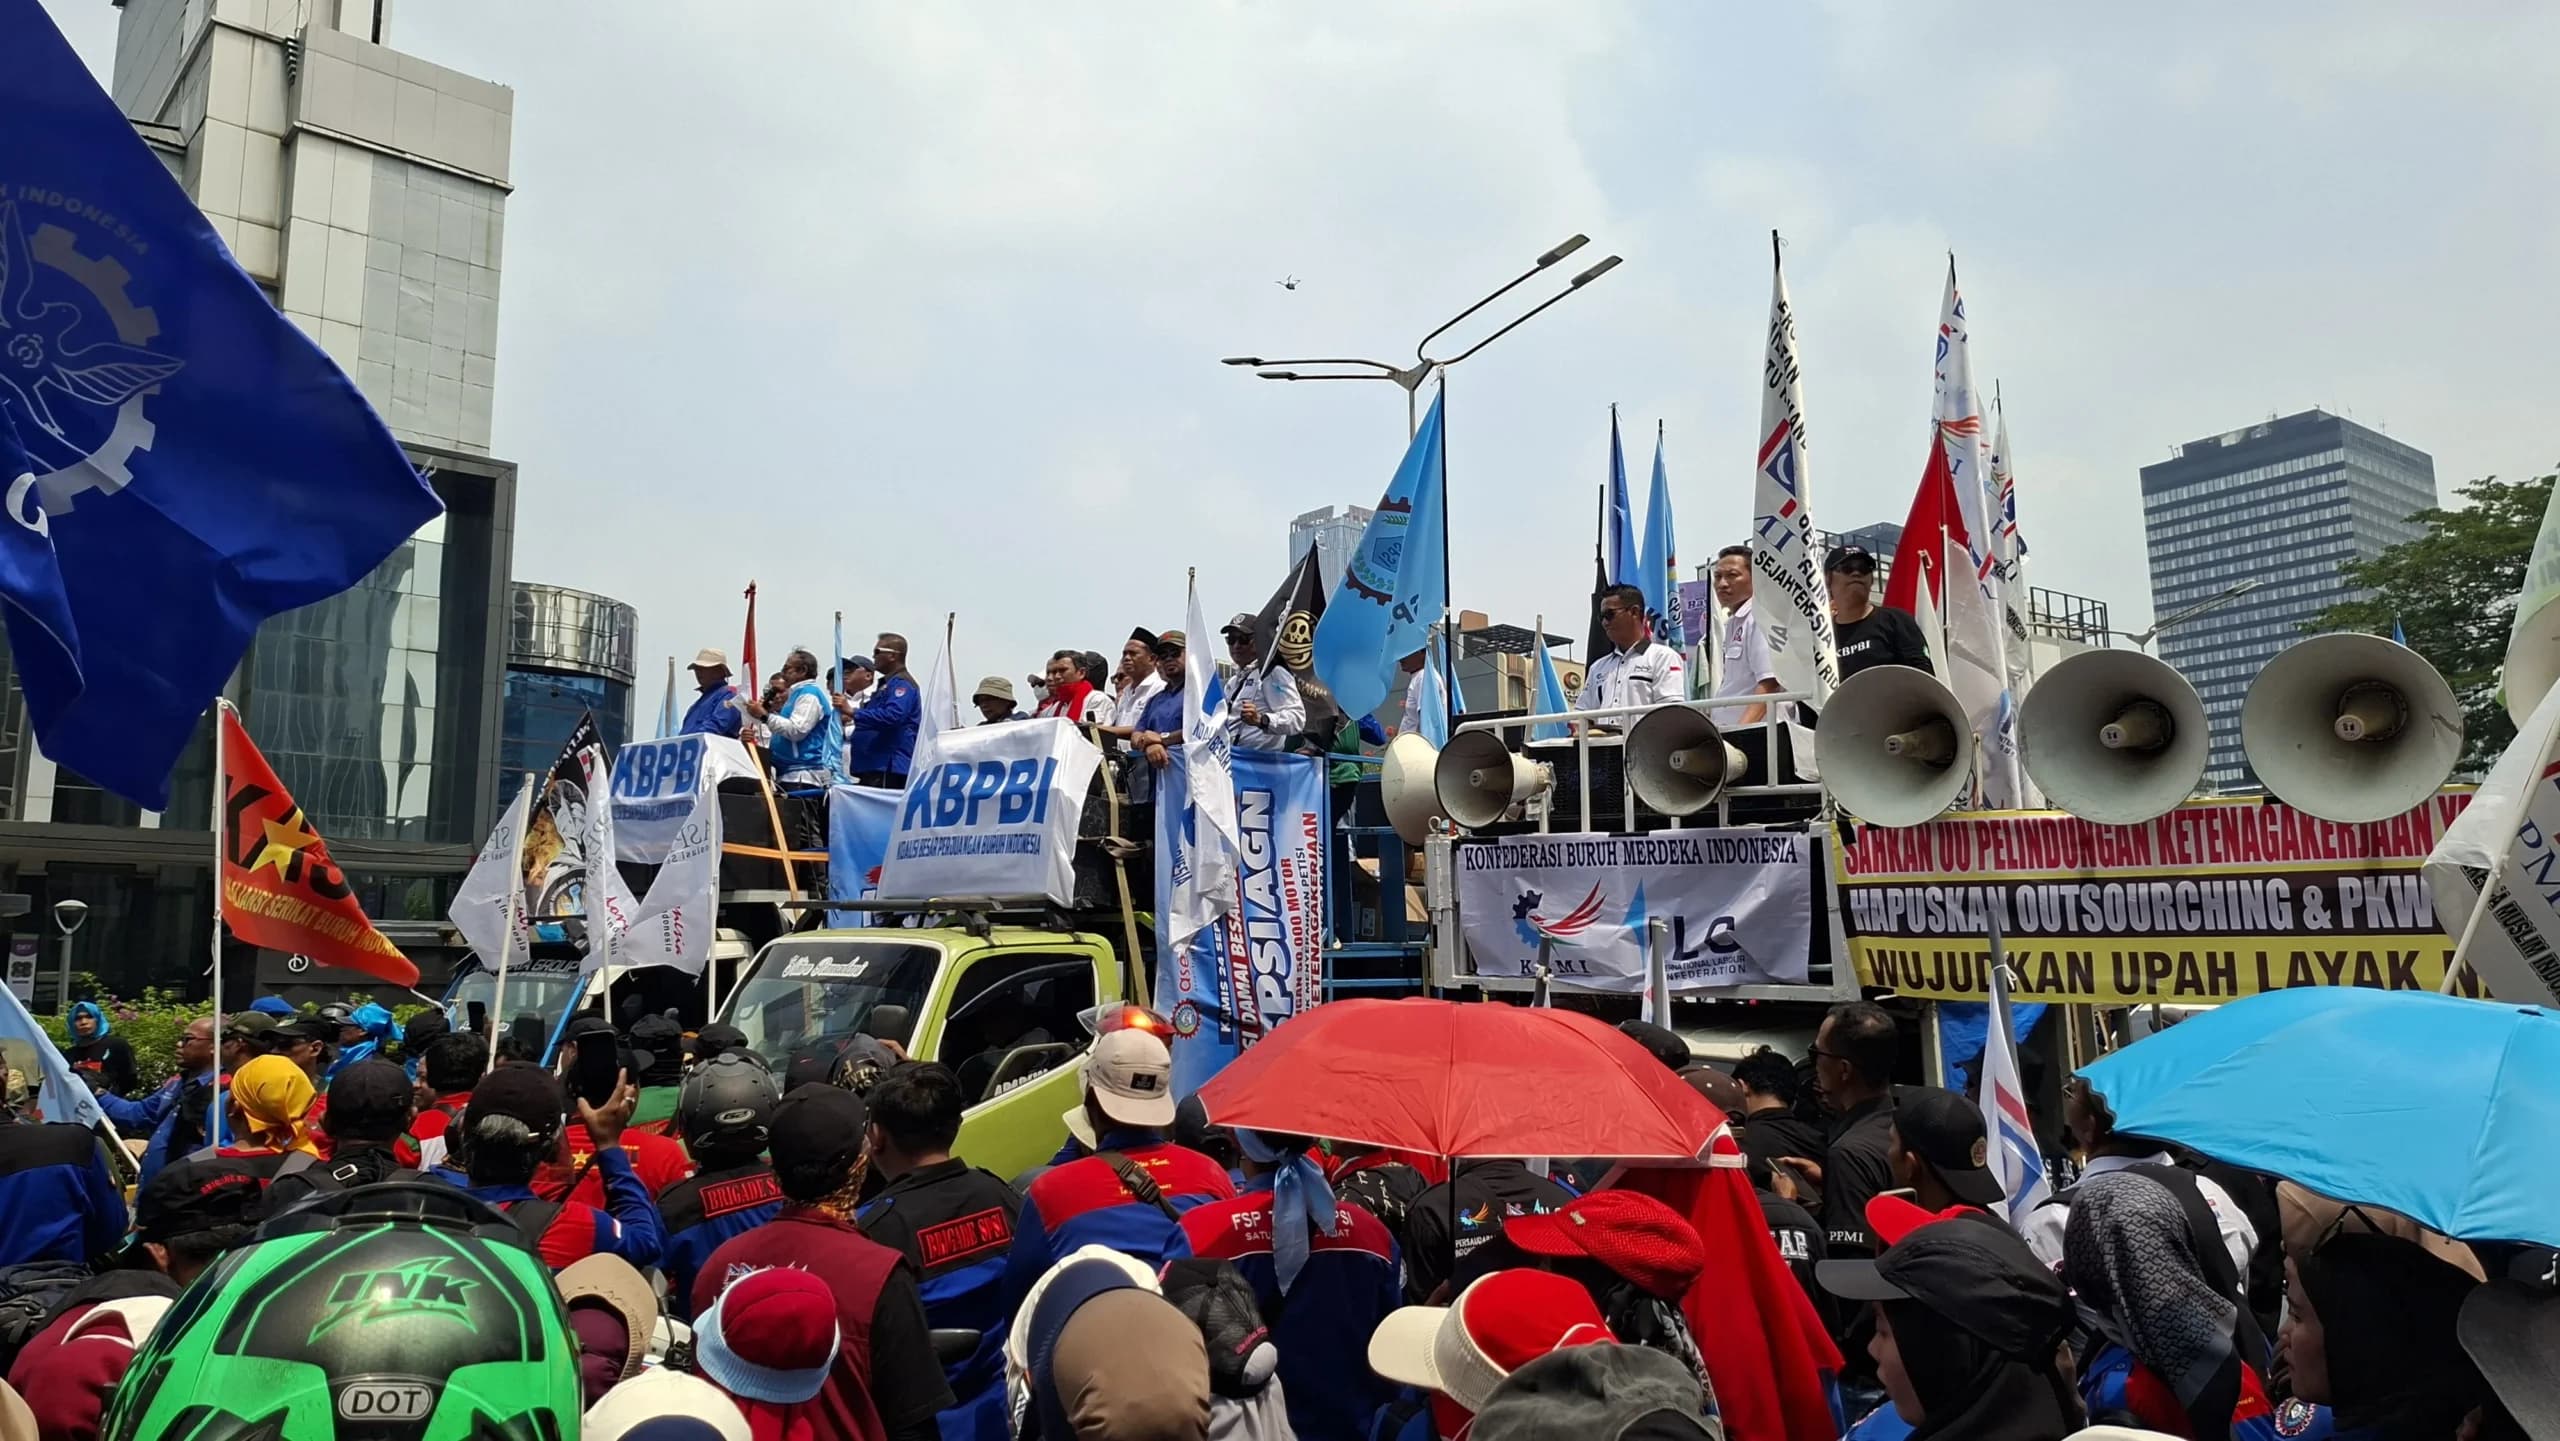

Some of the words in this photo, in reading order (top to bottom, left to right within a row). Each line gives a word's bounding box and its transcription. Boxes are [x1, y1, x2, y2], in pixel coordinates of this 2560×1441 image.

[19, 184, 149, 257] INDONESIA
[901, 756, 1059, 831] KBPBI
[1240, 789, 1277, 912] AGN
[1464, 843, 1563, 871] KONFEDERASI
[1567, 841, 1618, 867] BURUH
[1623, 840, 1702, 866] MERDEKA
[1706, 837, 1798, 865] INDONESIA
[1844, 823, 1934, 875] SAHKAN
[1938, 820, 1971, 873] UU
[1976, 816, 2152, 871] PELINDUNGAN
[2156, 800, 2434, 866] KETENAGAKERJAAN
[1280, 858, 1301, 912] MOTOR
[1295, 848, 1310, 887] PETISI
[1850, 885, 2011, 934] HAPUSKAN
[2015, 877, 2294, 933] OUTSOURCHING
[2302, 884, 2333, 930] &
[2494, 900, 2549, 961] MUSLIM
[1217, 956, 1229, 977] 24
[1667, 965, 1746, 980] NFEDERATION
[1713, 954, 1746, 966] LABOUR
[2111, 950, 2238, 996] UPAH
[2255, 950, 2422, 993] LAYAK
[1219, 981, 1233, 1033] KAMIS
[1233, 964, 1255, 1024] DAMAI
[708, 1181, 766, 1210] BRIGADE
[925, 1221, 978, 1260] BRIGADE
[978, 1213, 1004, 1242] SPSI
[1231, 1211, 1262, 1231] FSP
[1829, 1230, 1864, 1243] PPMI
[350, 1389, 422, 1415] DOT
